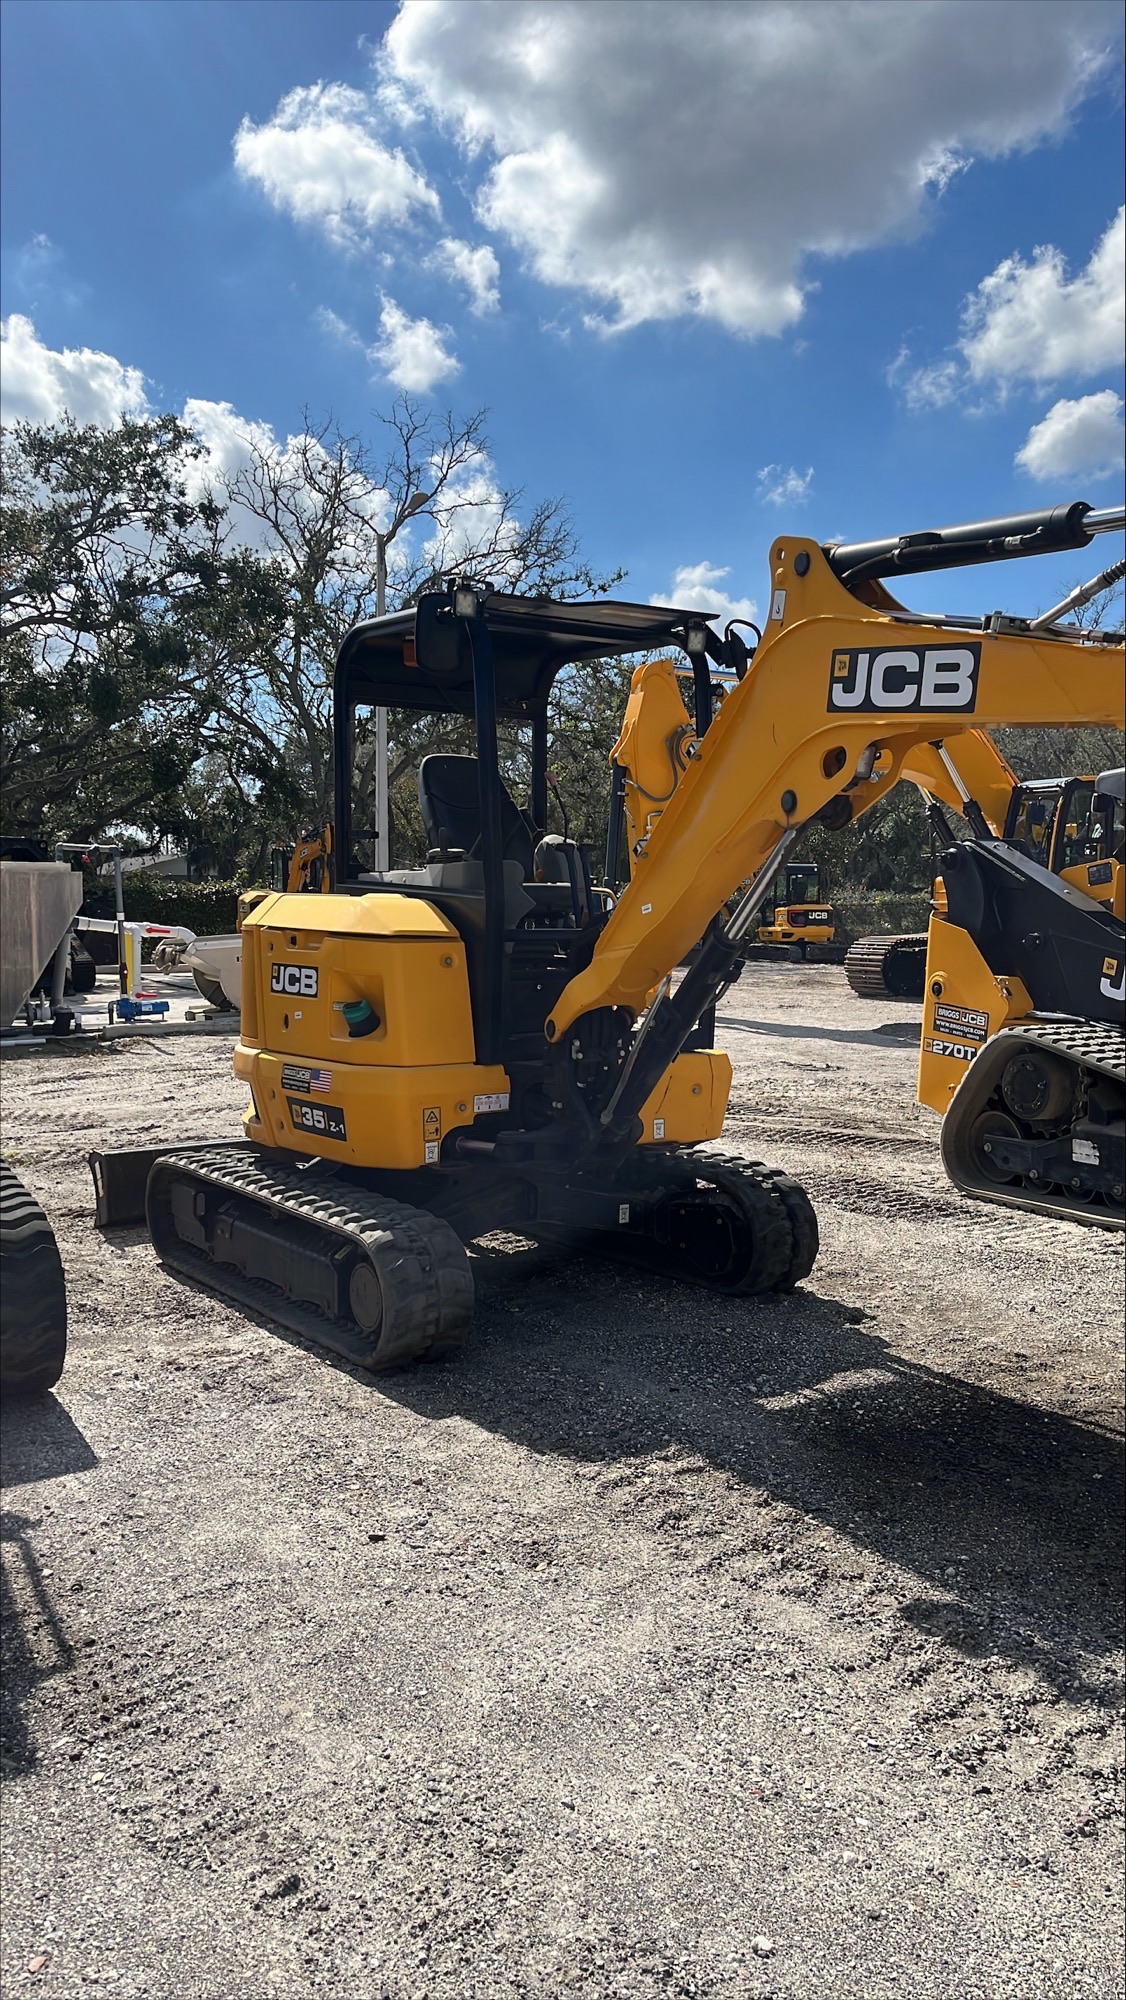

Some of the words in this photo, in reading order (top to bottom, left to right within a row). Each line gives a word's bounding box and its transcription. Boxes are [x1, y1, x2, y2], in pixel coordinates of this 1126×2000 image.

[832, 649, 974, 708] JCB
[272, 965, 317, 995] JCB
[938, 1008, 960, 1020] BRIGGS
[962, 1013, 985, 1026] JCB
[932, 1040, 976, 1060] 270T
[297, 1070, 310, 1079] JCB
[301, 1106, 326, 1129] 35
